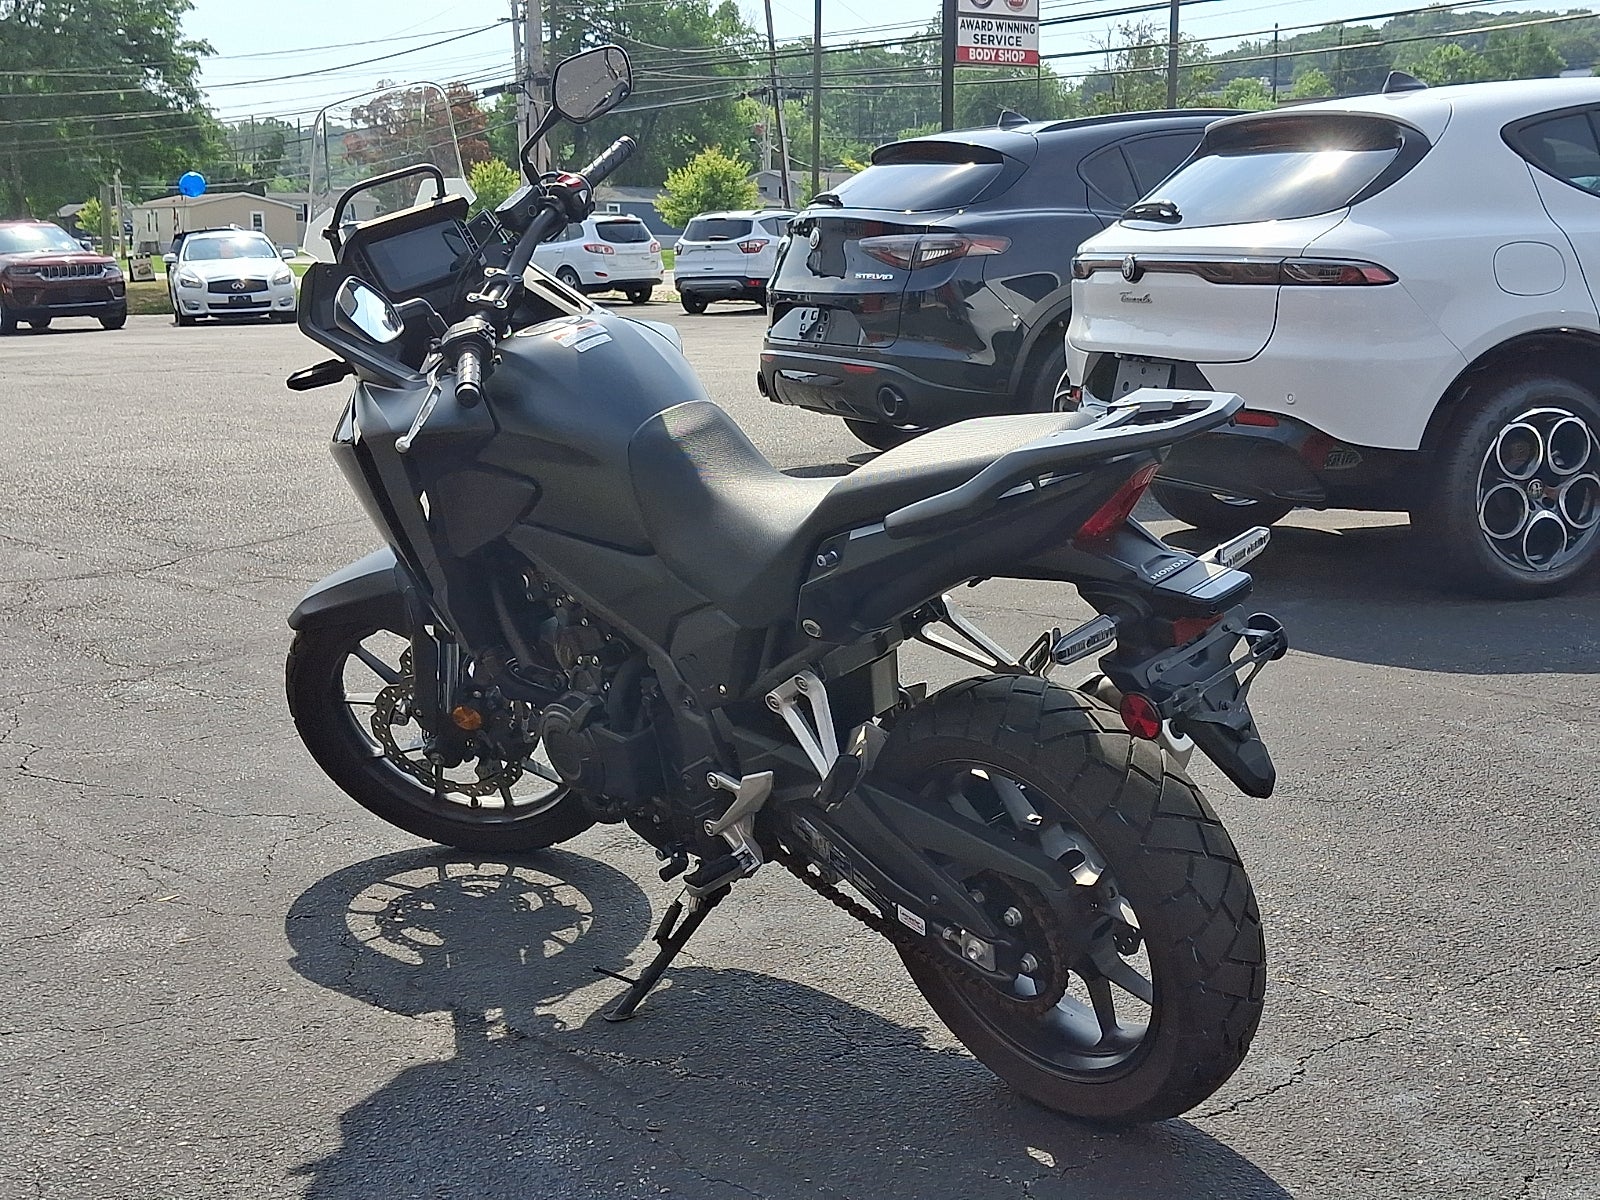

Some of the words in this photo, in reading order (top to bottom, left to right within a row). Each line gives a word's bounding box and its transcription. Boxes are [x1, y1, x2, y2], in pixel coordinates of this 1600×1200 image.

[960, 19, 993, 32] AWARD
[995, 22, 1036, 34] WINNING
[973, 34, 1022, 47] SERVICE
[969, 48, 996, 61] BODY
[998, 50, 1026, 62] SHOP
[1150, 559, 1189, 580] HONDA
